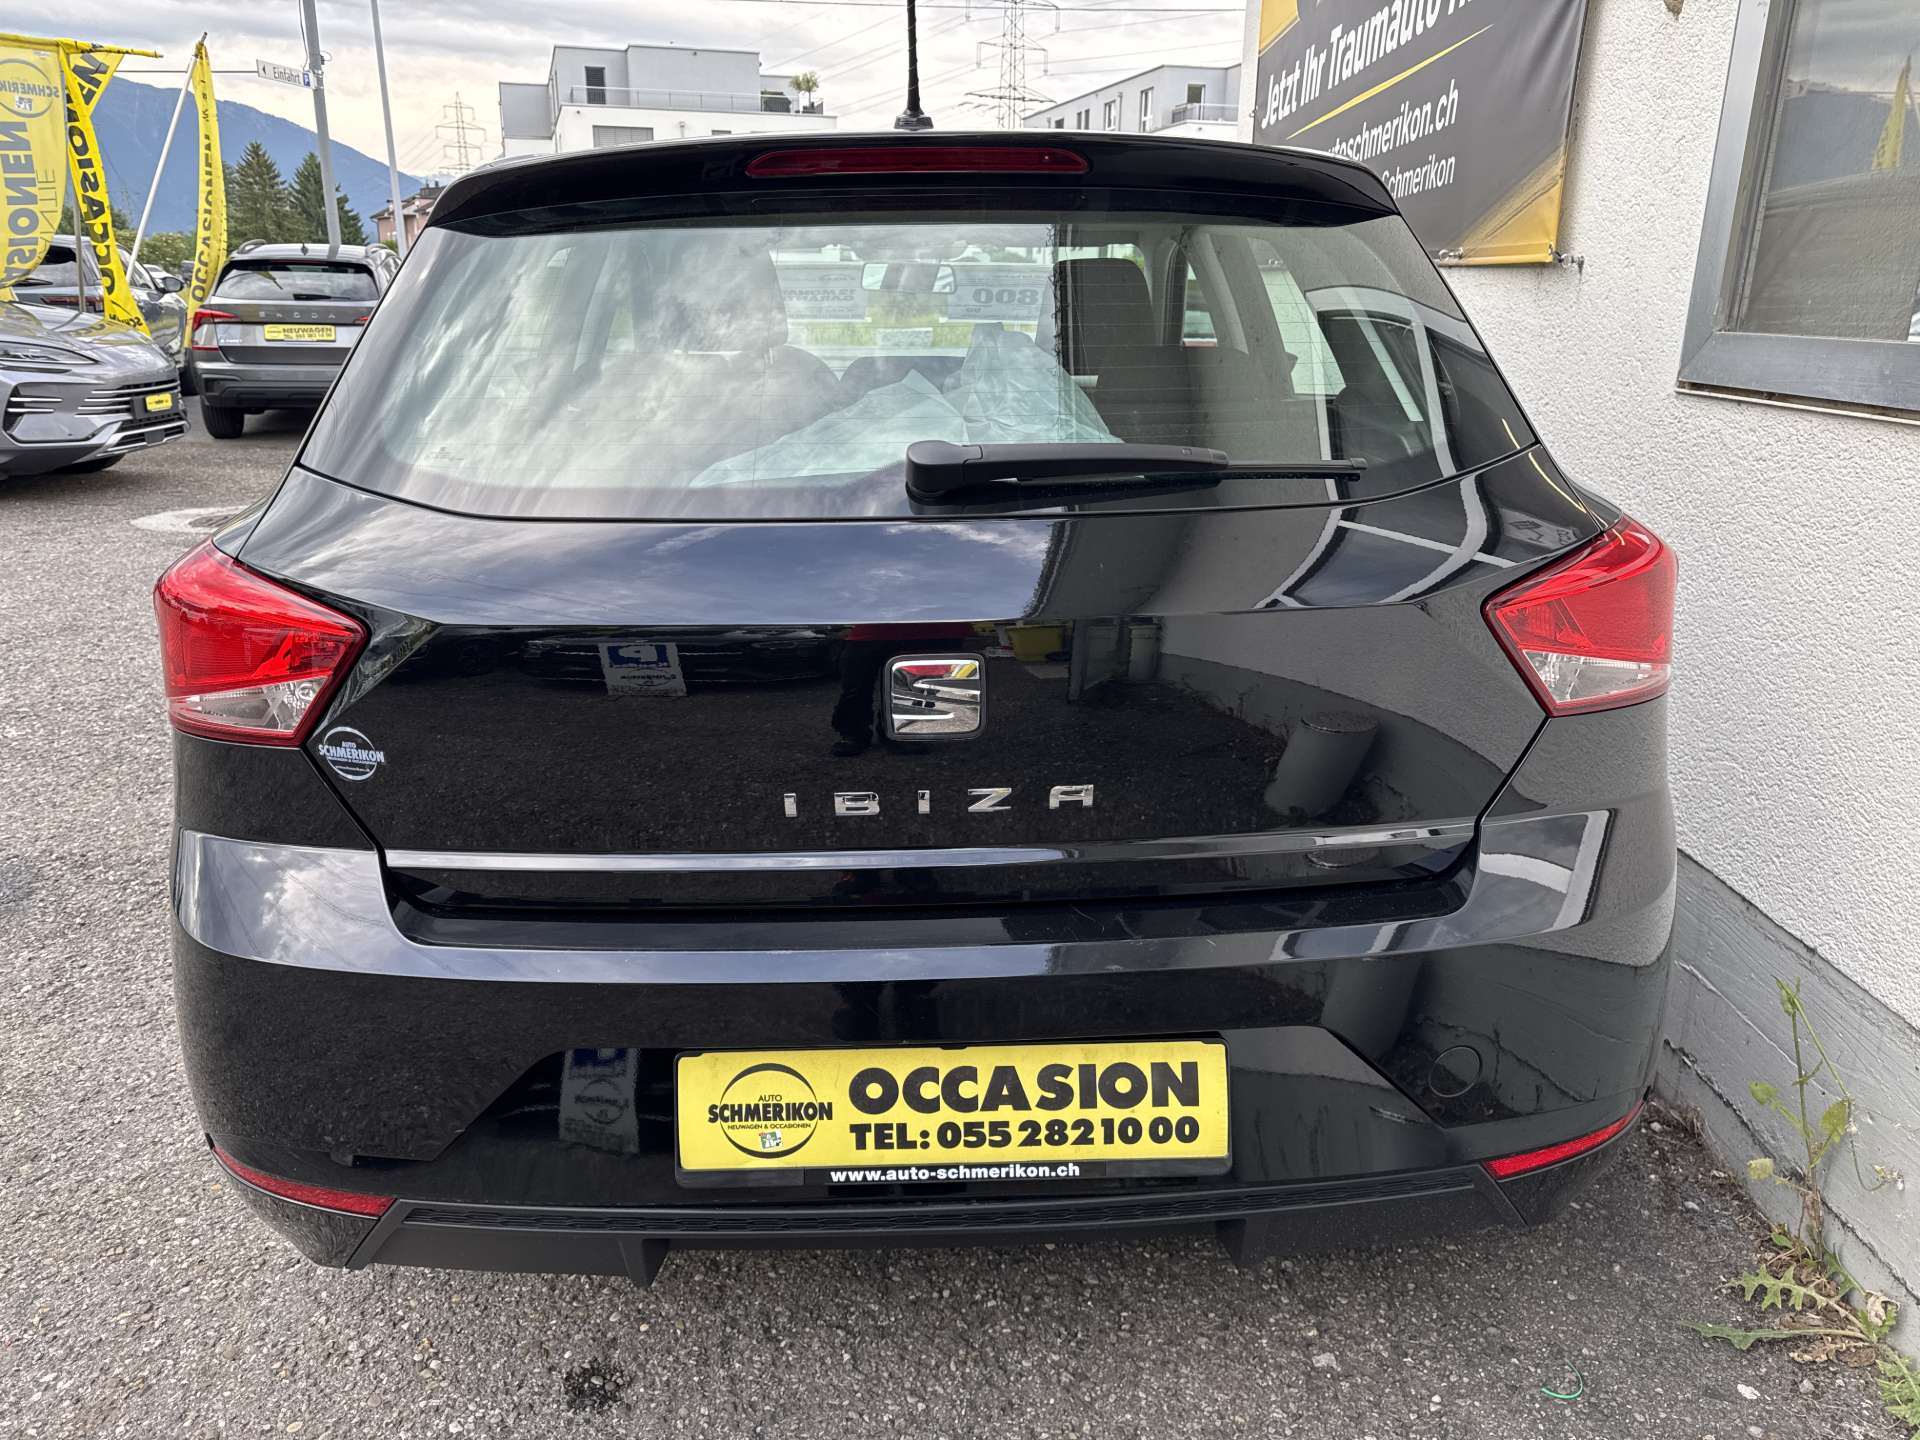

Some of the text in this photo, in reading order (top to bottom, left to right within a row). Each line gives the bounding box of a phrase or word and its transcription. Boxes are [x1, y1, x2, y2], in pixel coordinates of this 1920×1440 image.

[273, 66, 302, 84] Einfahrt
[1261, 0, 1441, 129] Jetzt Ihr Traumauto
[1329, 78, 1459, 161] toschmerikon.ch
[318, 744, 385, 763] SCHMERIKON
[783, 784, 1095, 818] IBIZA
[757, 1094, 783, 1102] AUTO
[848, 1062, 1200, 1115] OCCASION
[707, 1101, 834, 1124] SCHMERIKON
[727, 1123, 763, 1131] NEUWAGEN
[769, 1122, 812, 1130] OCCASIONEN
[849, 1123, 930, 1151] TEL:
[936, 1120, 1012, 1148] 055
[1148, 1115, 1200, 1144] 00
[829, 1162, 1081, 1183] www.auto-schmerikon.ch
